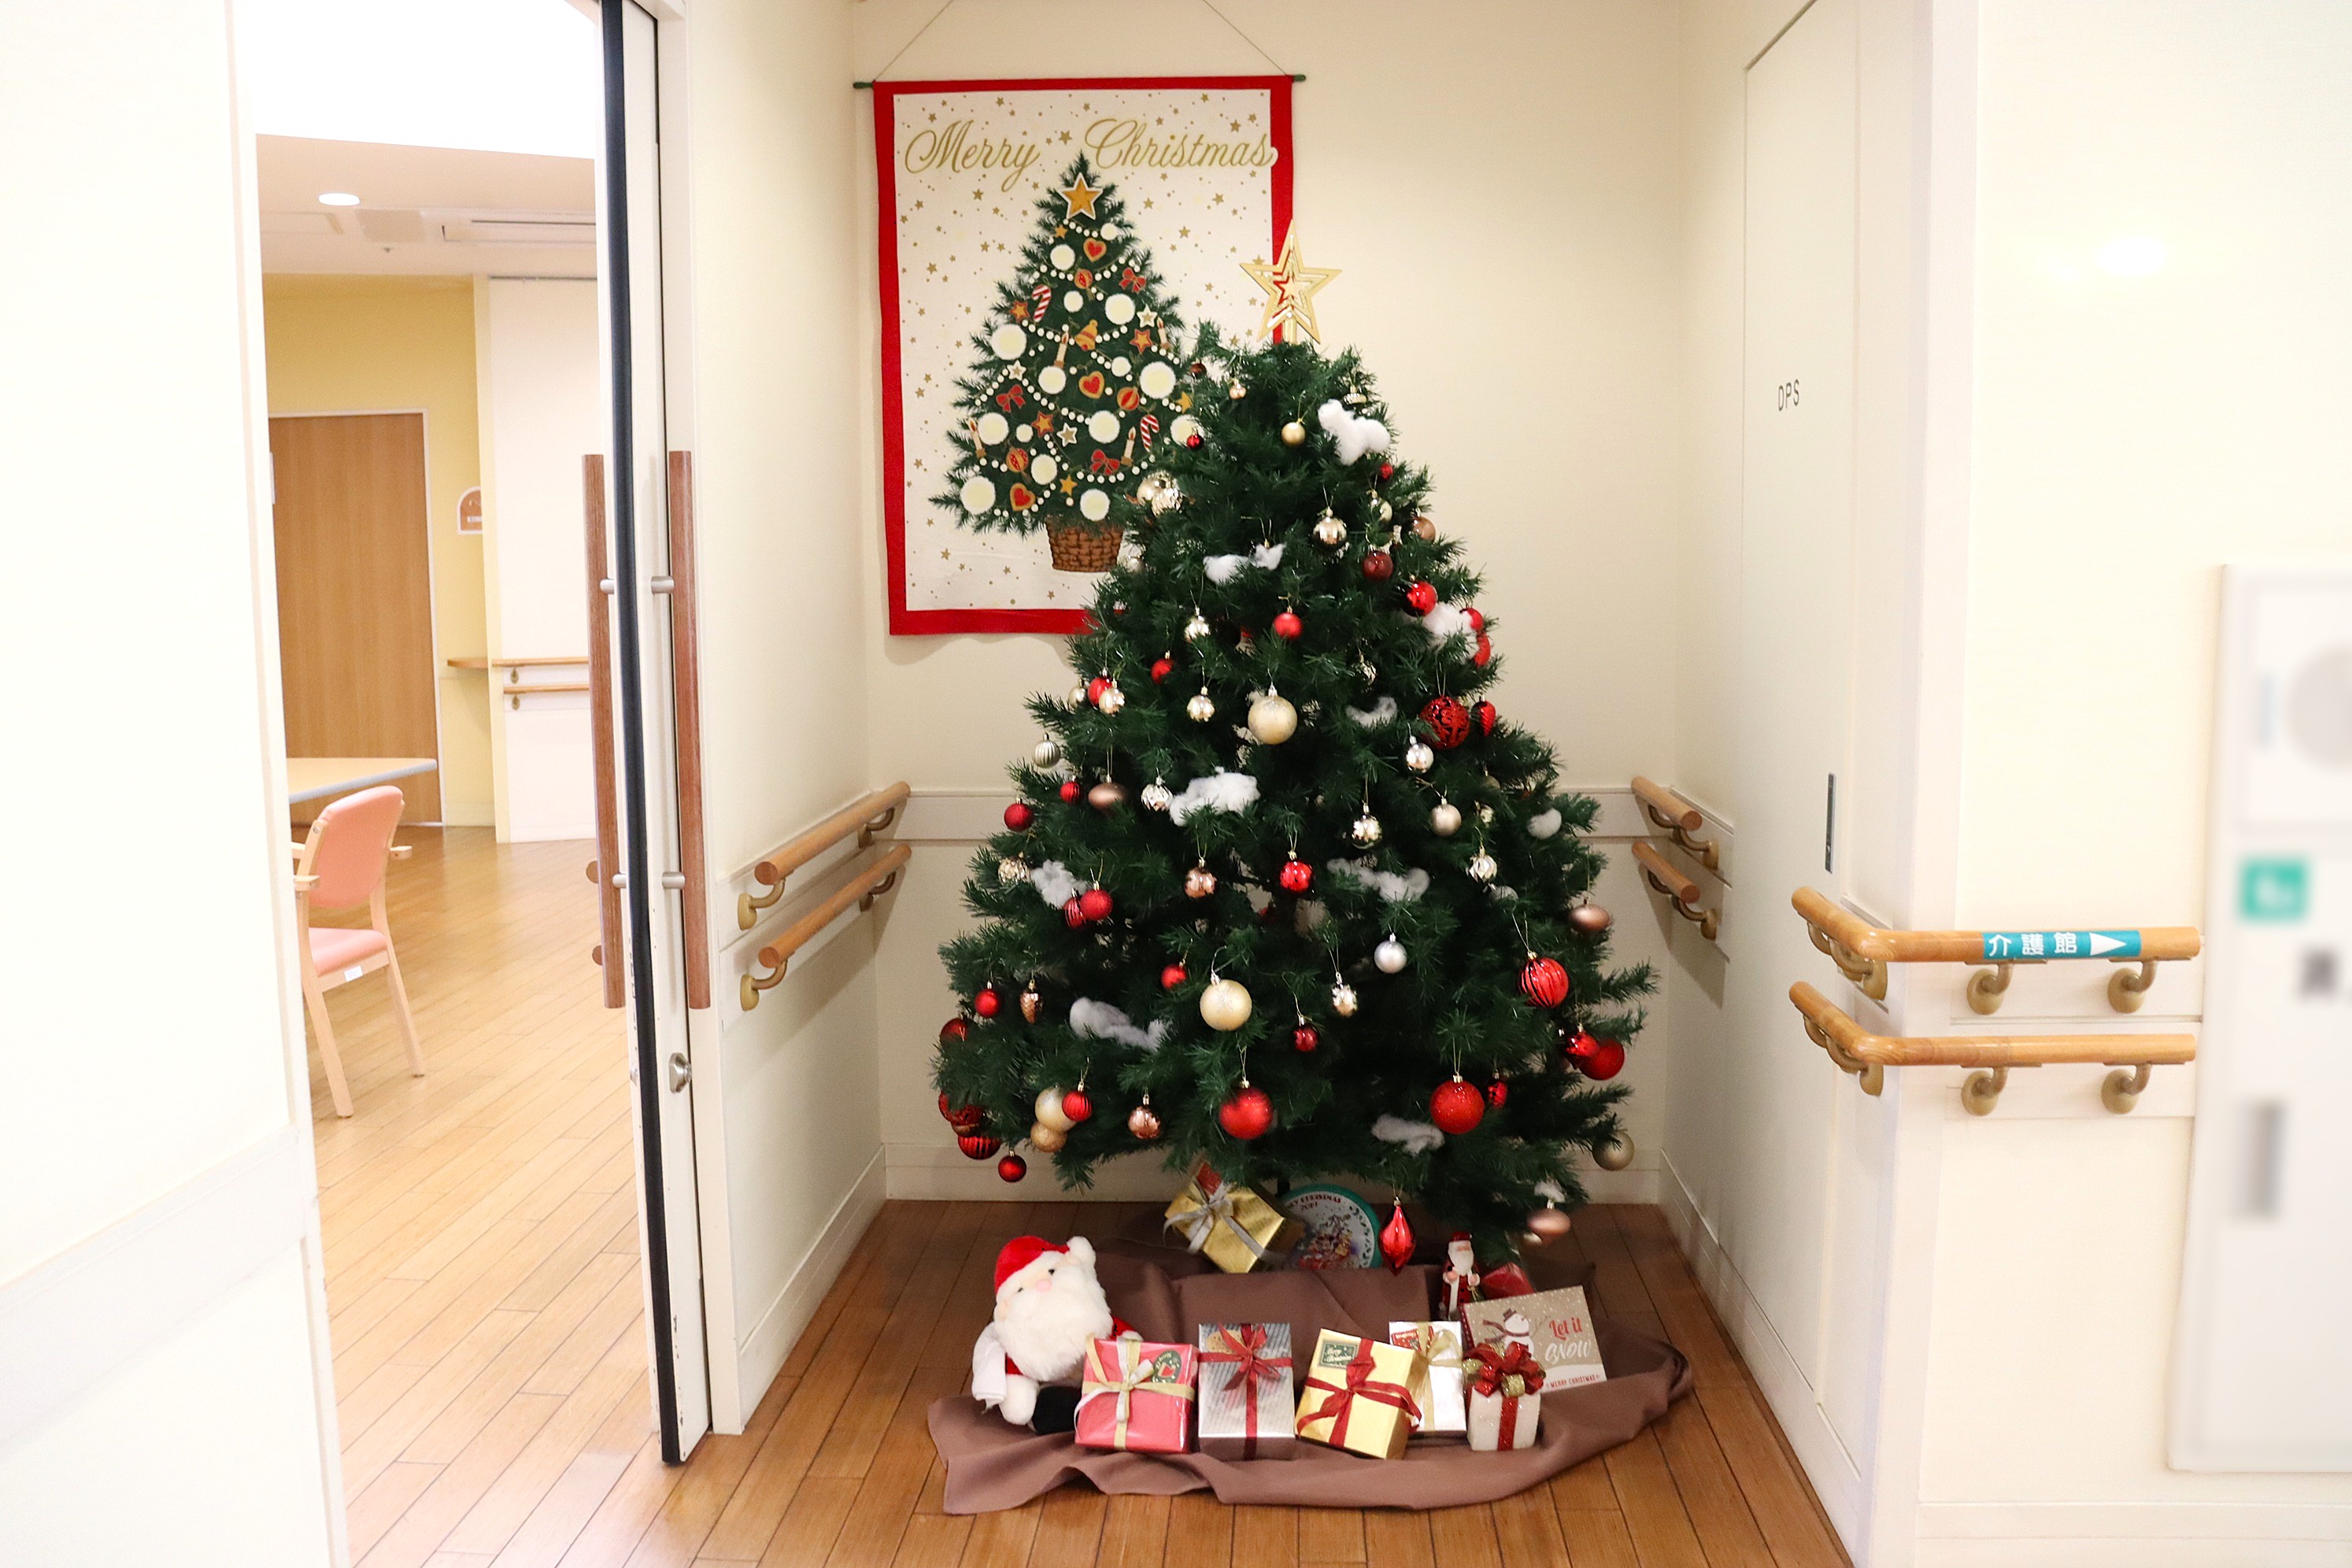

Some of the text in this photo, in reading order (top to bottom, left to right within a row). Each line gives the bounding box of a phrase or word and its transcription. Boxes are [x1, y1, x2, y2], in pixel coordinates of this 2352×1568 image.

[904, 118, 1274, 193] Merry Christmas
[1777, 379, 1800, 412] DPS
[1988, 931, 2078, 957] 介護館
[1548, 1317, 1583, 1341] Let it
[1550, 1374, 1596, 1388] MERRY CHRISTMAS
